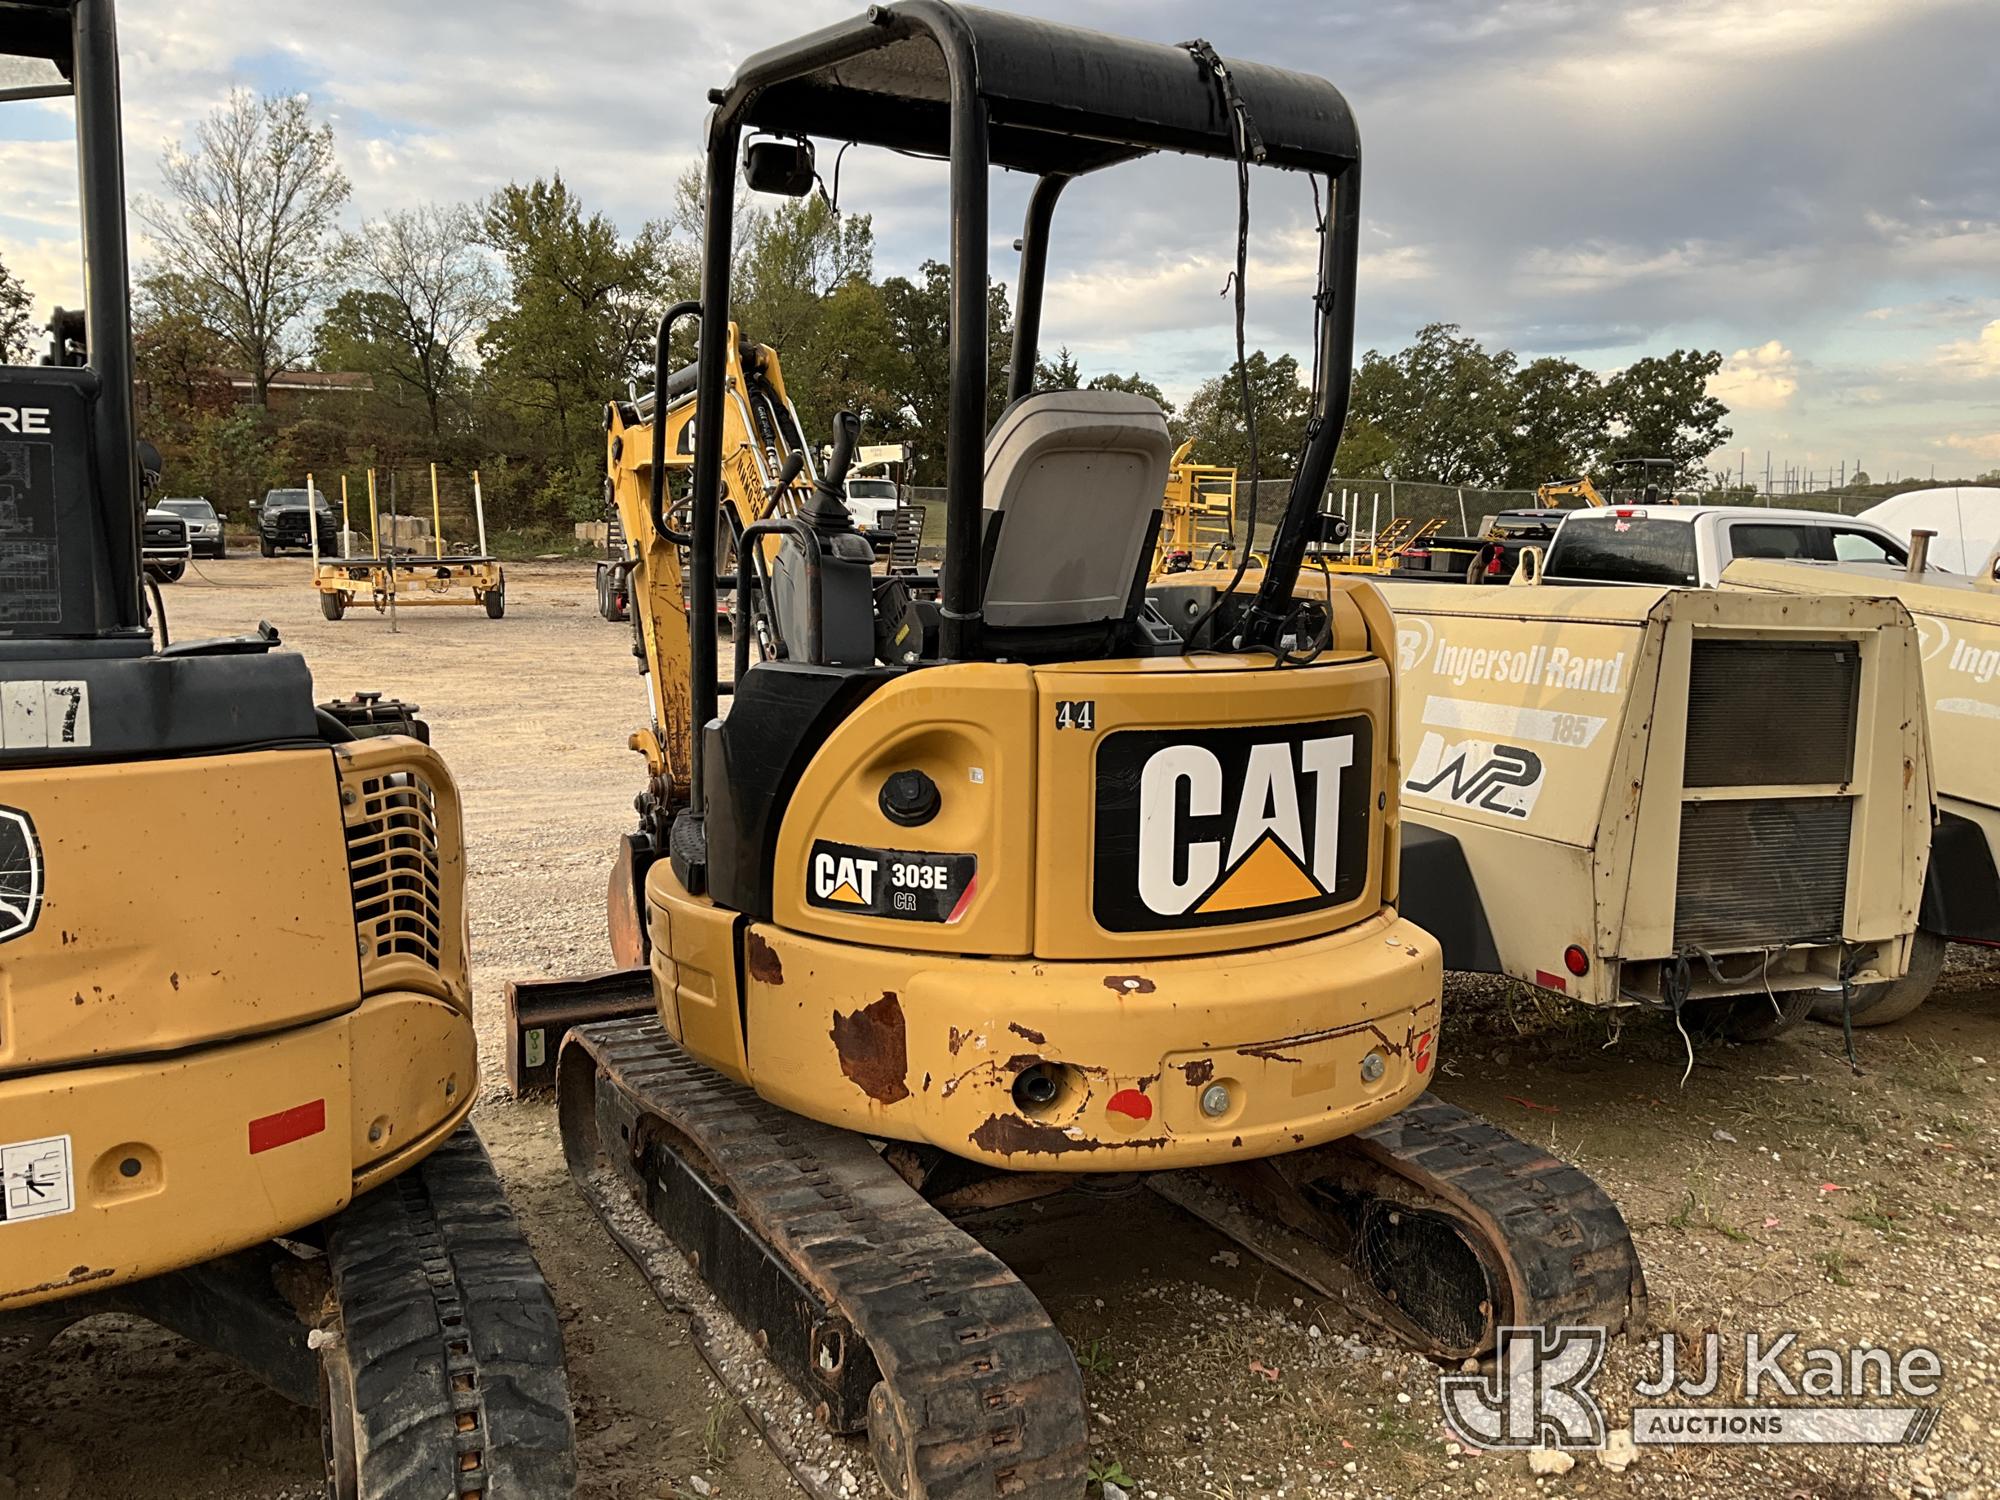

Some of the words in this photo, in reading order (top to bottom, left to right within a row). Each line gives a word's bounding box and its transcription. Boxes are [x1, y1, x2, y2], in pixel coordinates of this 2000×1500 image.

[1949, 638, 2000, 683] Ing
[1058, 701, 1092, 729] 44
[1551, 714, 1589, 745] 185
[1138, 734, 1354, 916] CAT
[815, 853, 878, 905] CAT
[892, 863, 948, 890] 303E
[893, 891, 917, 911] CR
